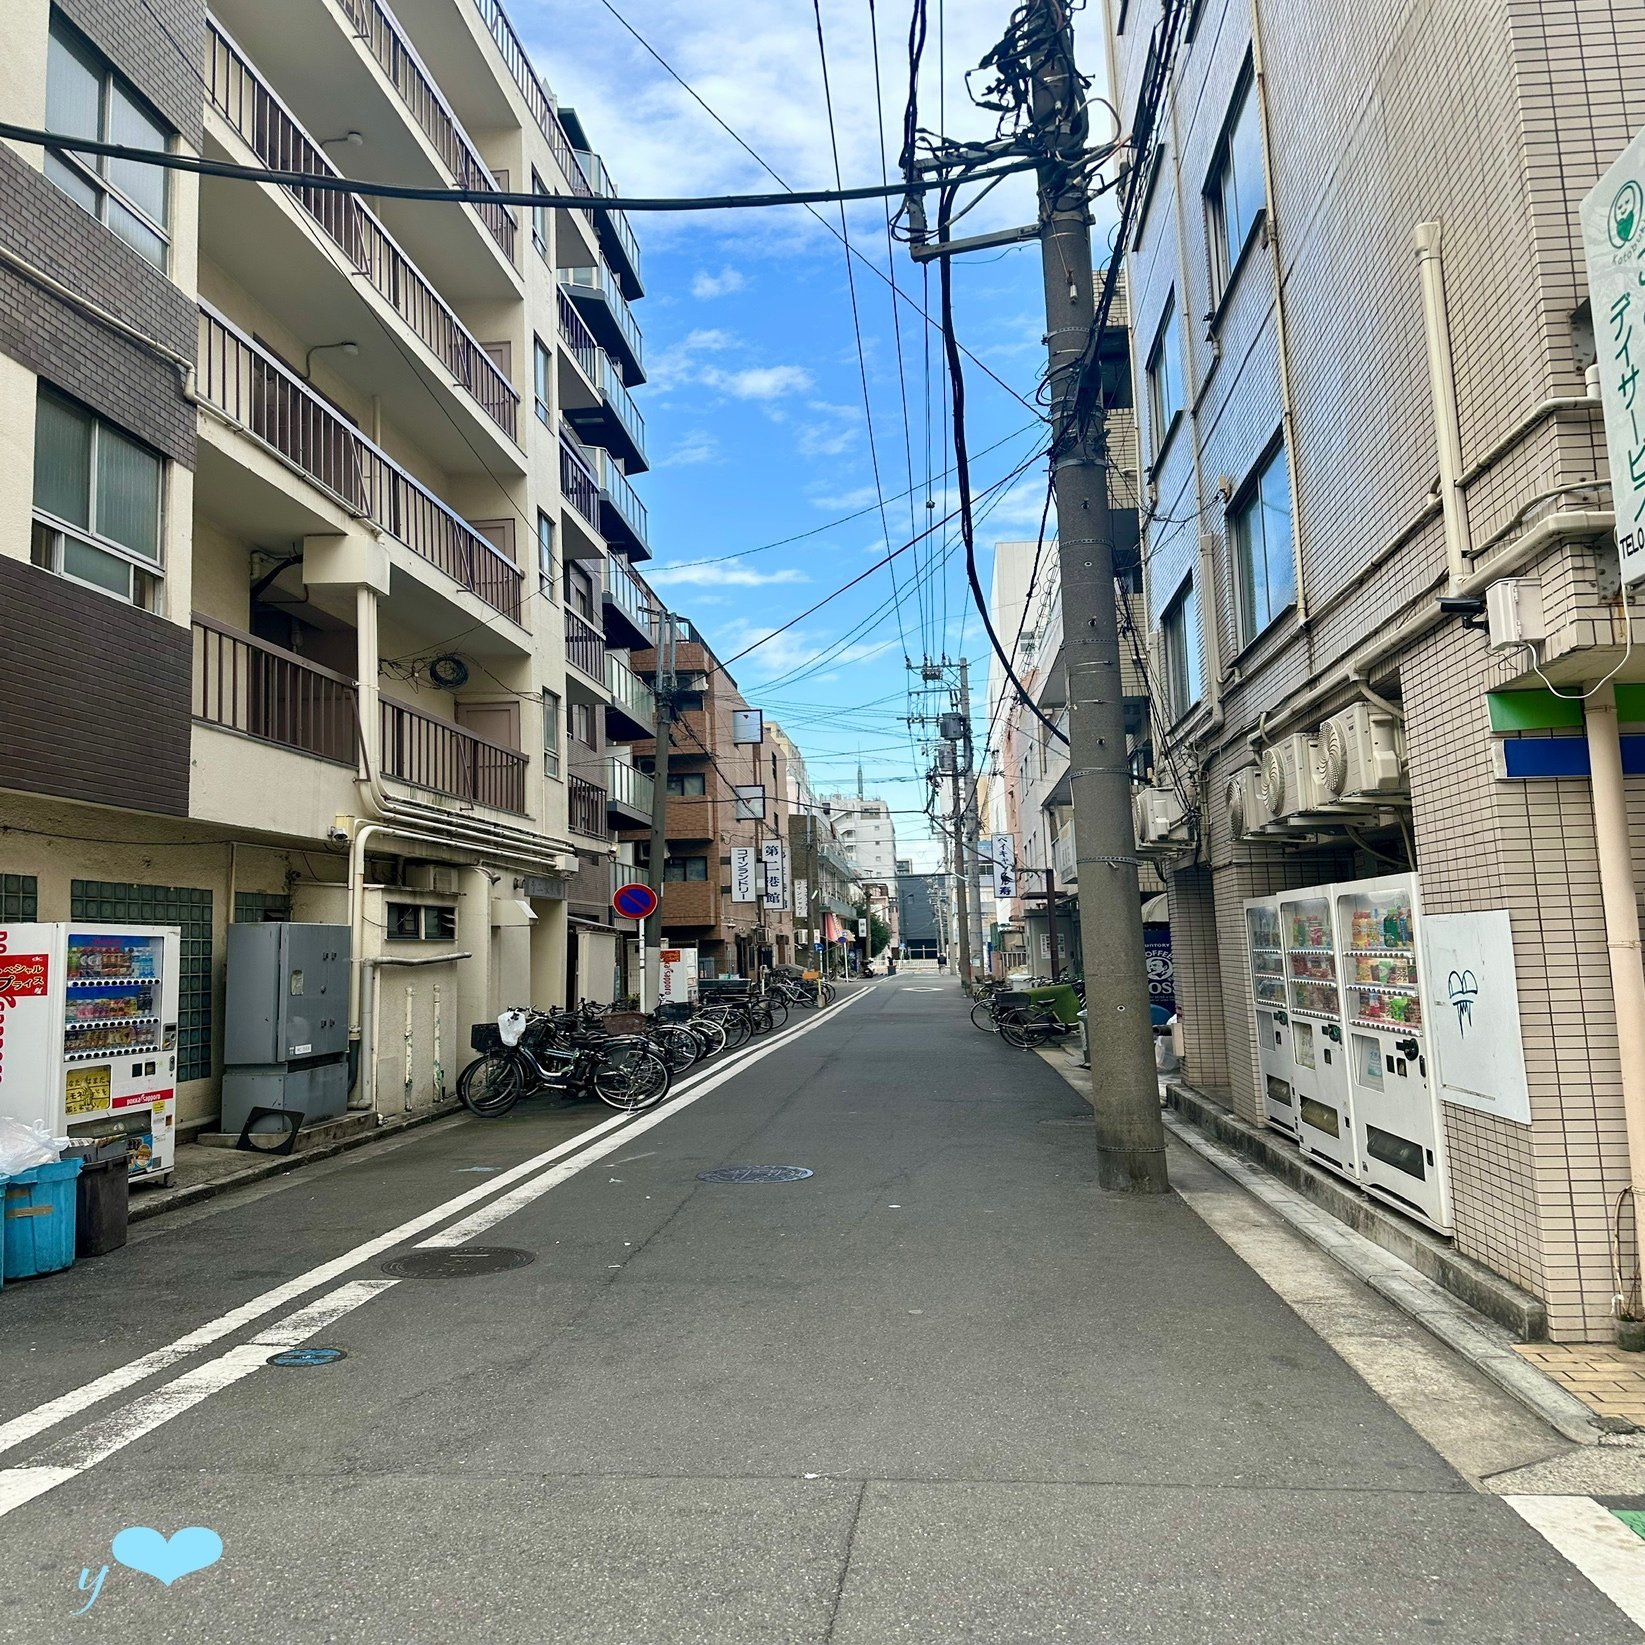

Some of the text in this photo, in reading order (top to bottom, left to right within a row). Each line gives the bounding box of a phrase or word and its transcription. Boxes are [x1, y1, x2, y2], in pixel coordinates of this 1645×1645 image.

[1611, 225, 1645, 265] Kotobuk
[737, 849, 749, 900] コインランドリー
[0, 963, 44, 974] ペシャル
[1148, 982, 1174, 994] OS
